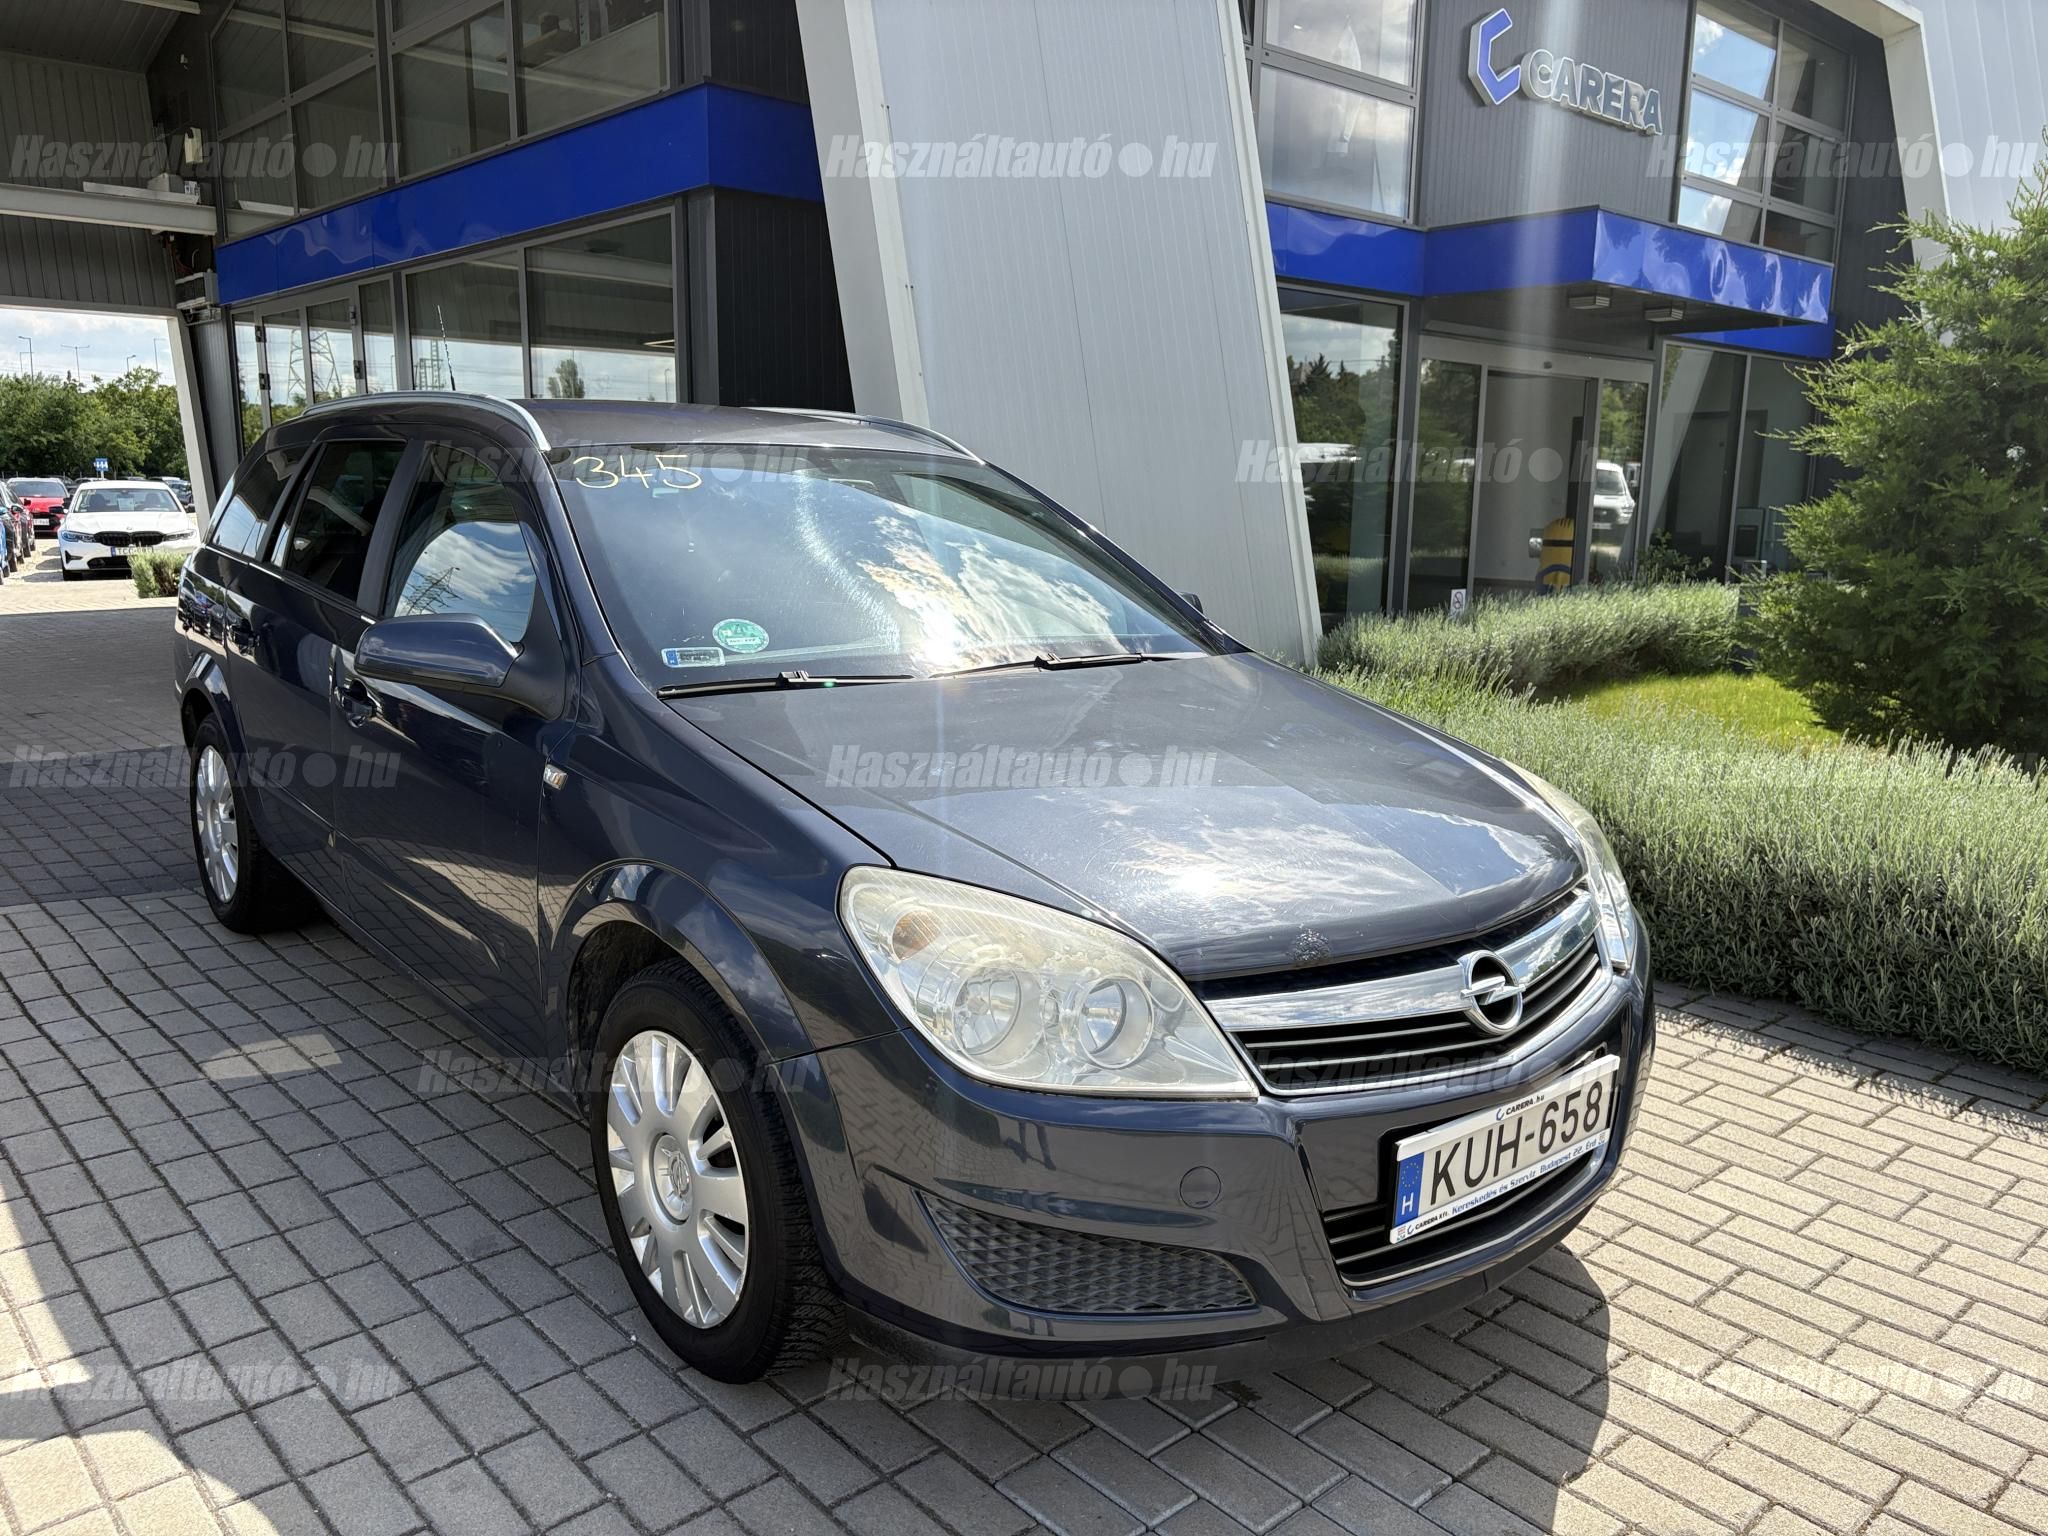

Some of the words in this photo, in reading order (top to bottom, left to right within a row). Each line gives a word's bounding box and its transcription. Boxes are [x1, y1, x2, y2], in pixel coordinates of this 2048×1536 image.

[1522, 49, 1662, 135] CARERA
[573, 455, 701, 488] 345
[1430, 1081, 1603, 1206] KUH-658
[1415, 1215, 1438, 1230] CARERA
[1451, 1188, 1498, 1216] Kereskedés
[1498, 1183, 1508, 1194] és
[1510, 1169, 1536, 1188] Szerviz
[1539, 1151, 1571, 1174] Budapest
